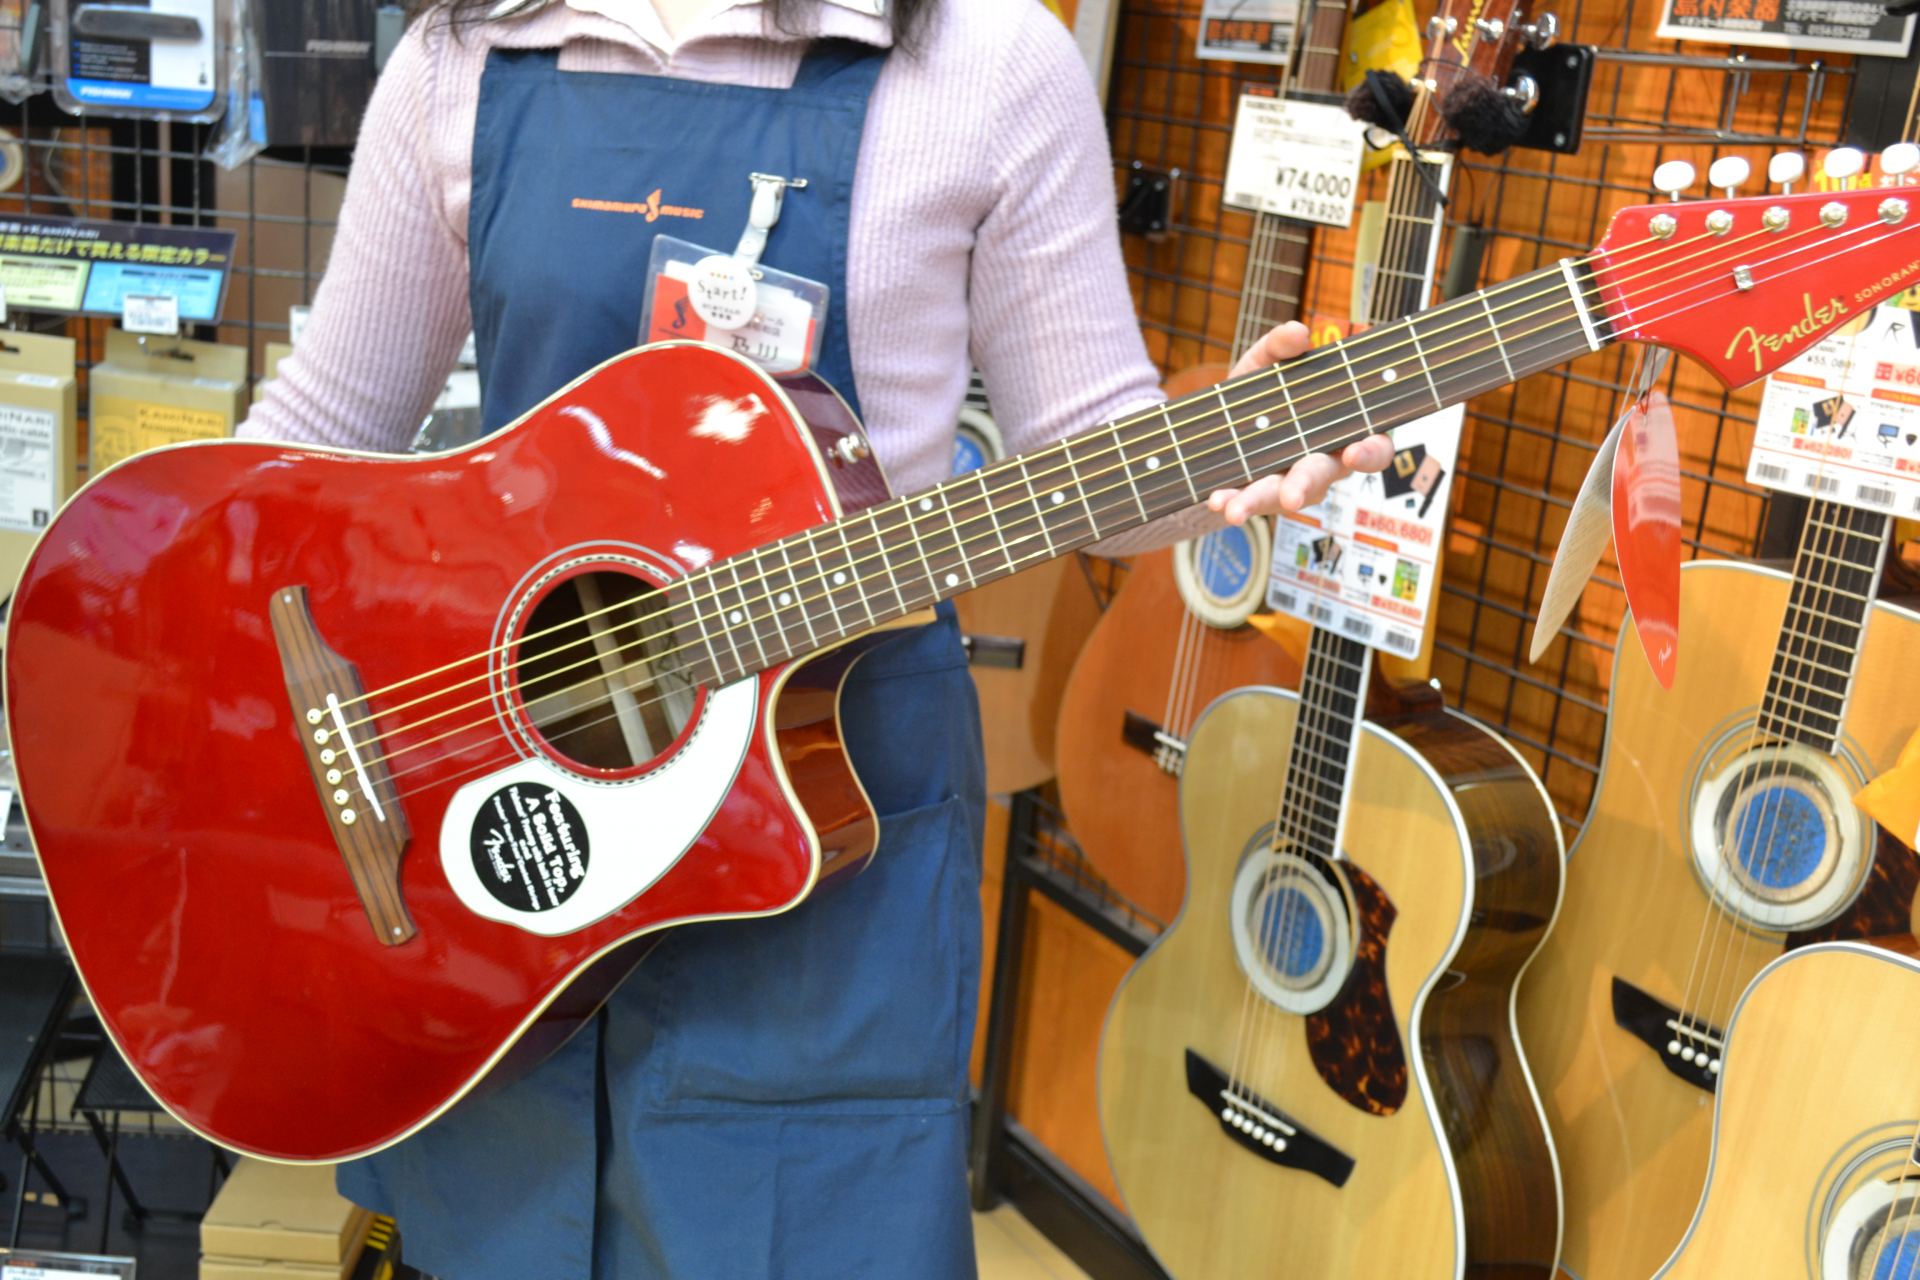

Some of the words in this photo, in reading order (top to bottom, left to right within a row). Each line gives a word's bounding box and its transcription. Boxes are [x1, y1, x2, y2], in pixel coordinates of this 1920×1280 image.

[1725, 292, 1849, 373] Fender
[525, 797, 540, 812] A
[483, 828, 514, 883] Fender
[532, 812, 557, 855] Solid
[544, 790, 585, 879] Featuring
